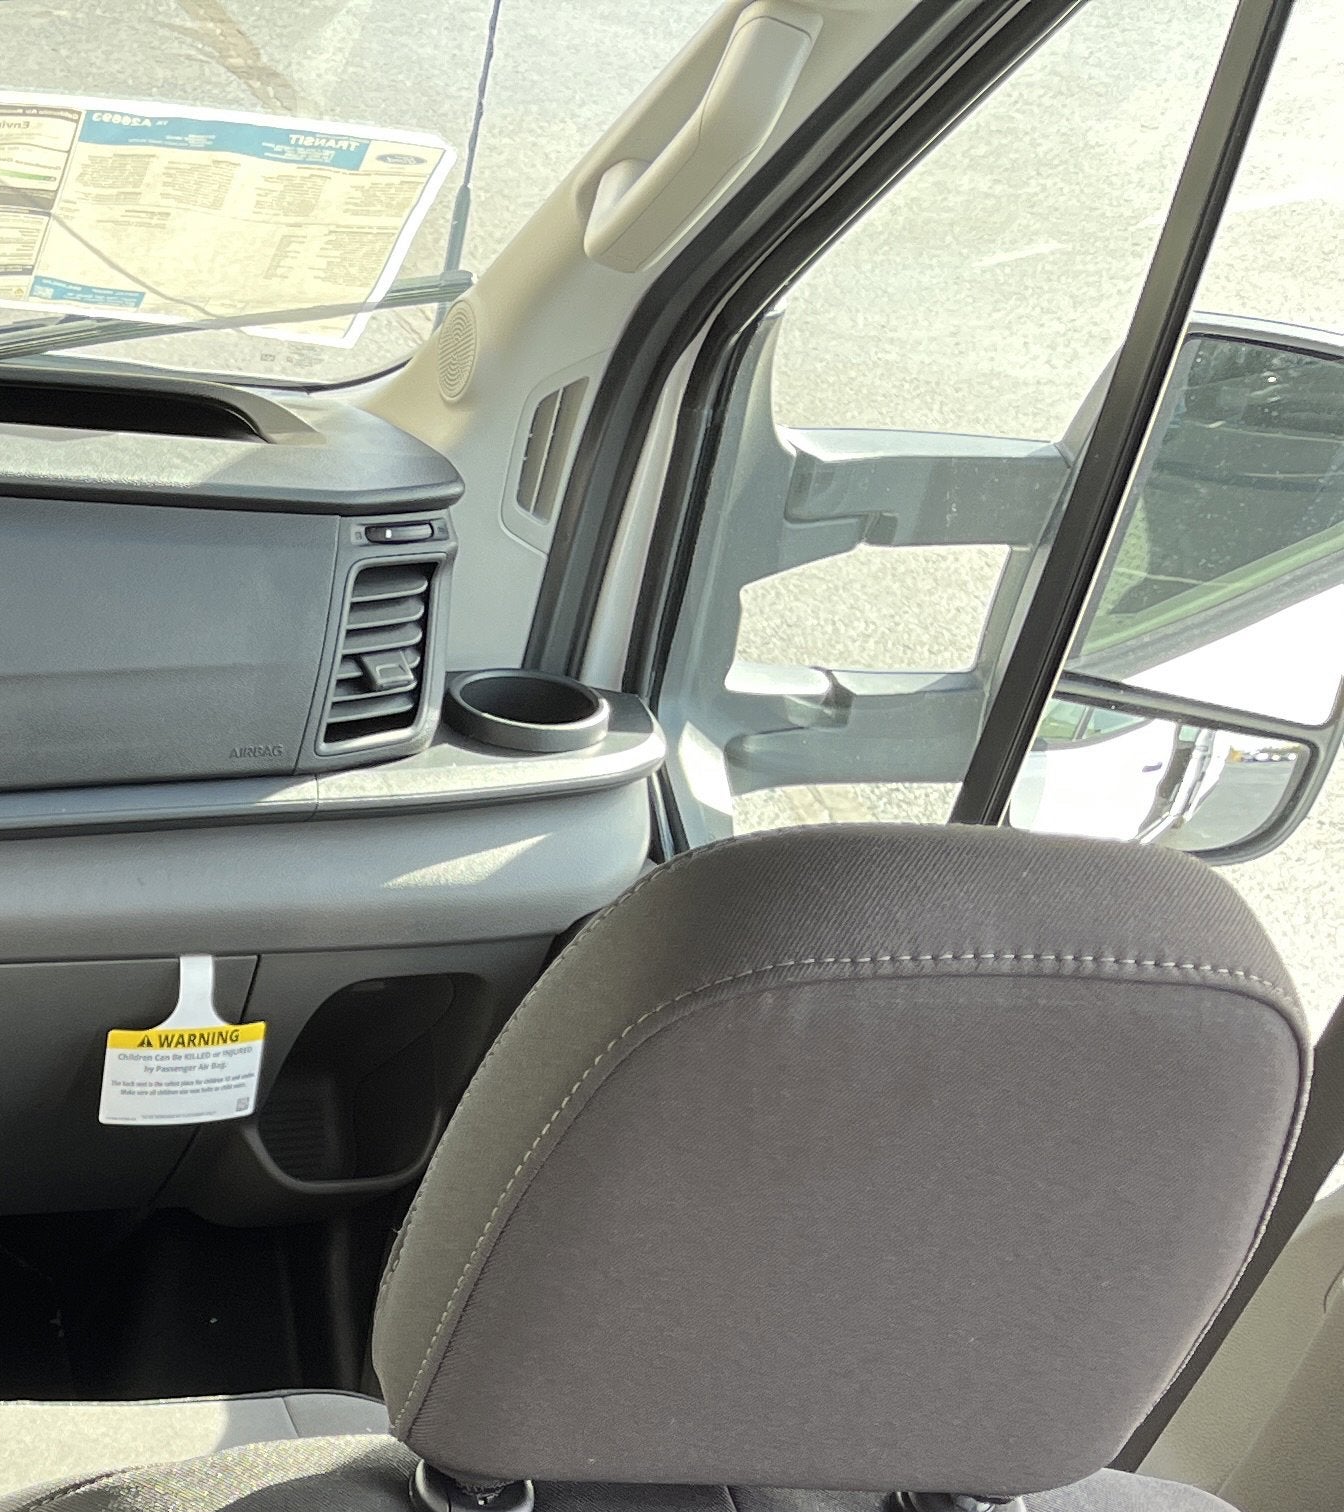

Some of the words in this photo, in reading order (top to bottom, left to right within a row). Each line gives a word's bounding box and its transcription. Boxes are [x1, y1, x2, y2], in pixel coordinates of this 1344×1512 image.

[228, 744, 284, 759] AIRBAG
[158, 1029, 240, 1049] WARNING
[118, 1052, 153, 1062] Children
[154, 1053, 170, 1061] Can
[172, 1052, 183, 1061] Be
[184, 1051, 211, 1061] KILLED
[222, 1046, 253, 1057] INJURED
[144, 1065, 155, 1074] by
[156, 1063, 197, 1074] Passenger
[198, 1062, 210, 1071] Air
